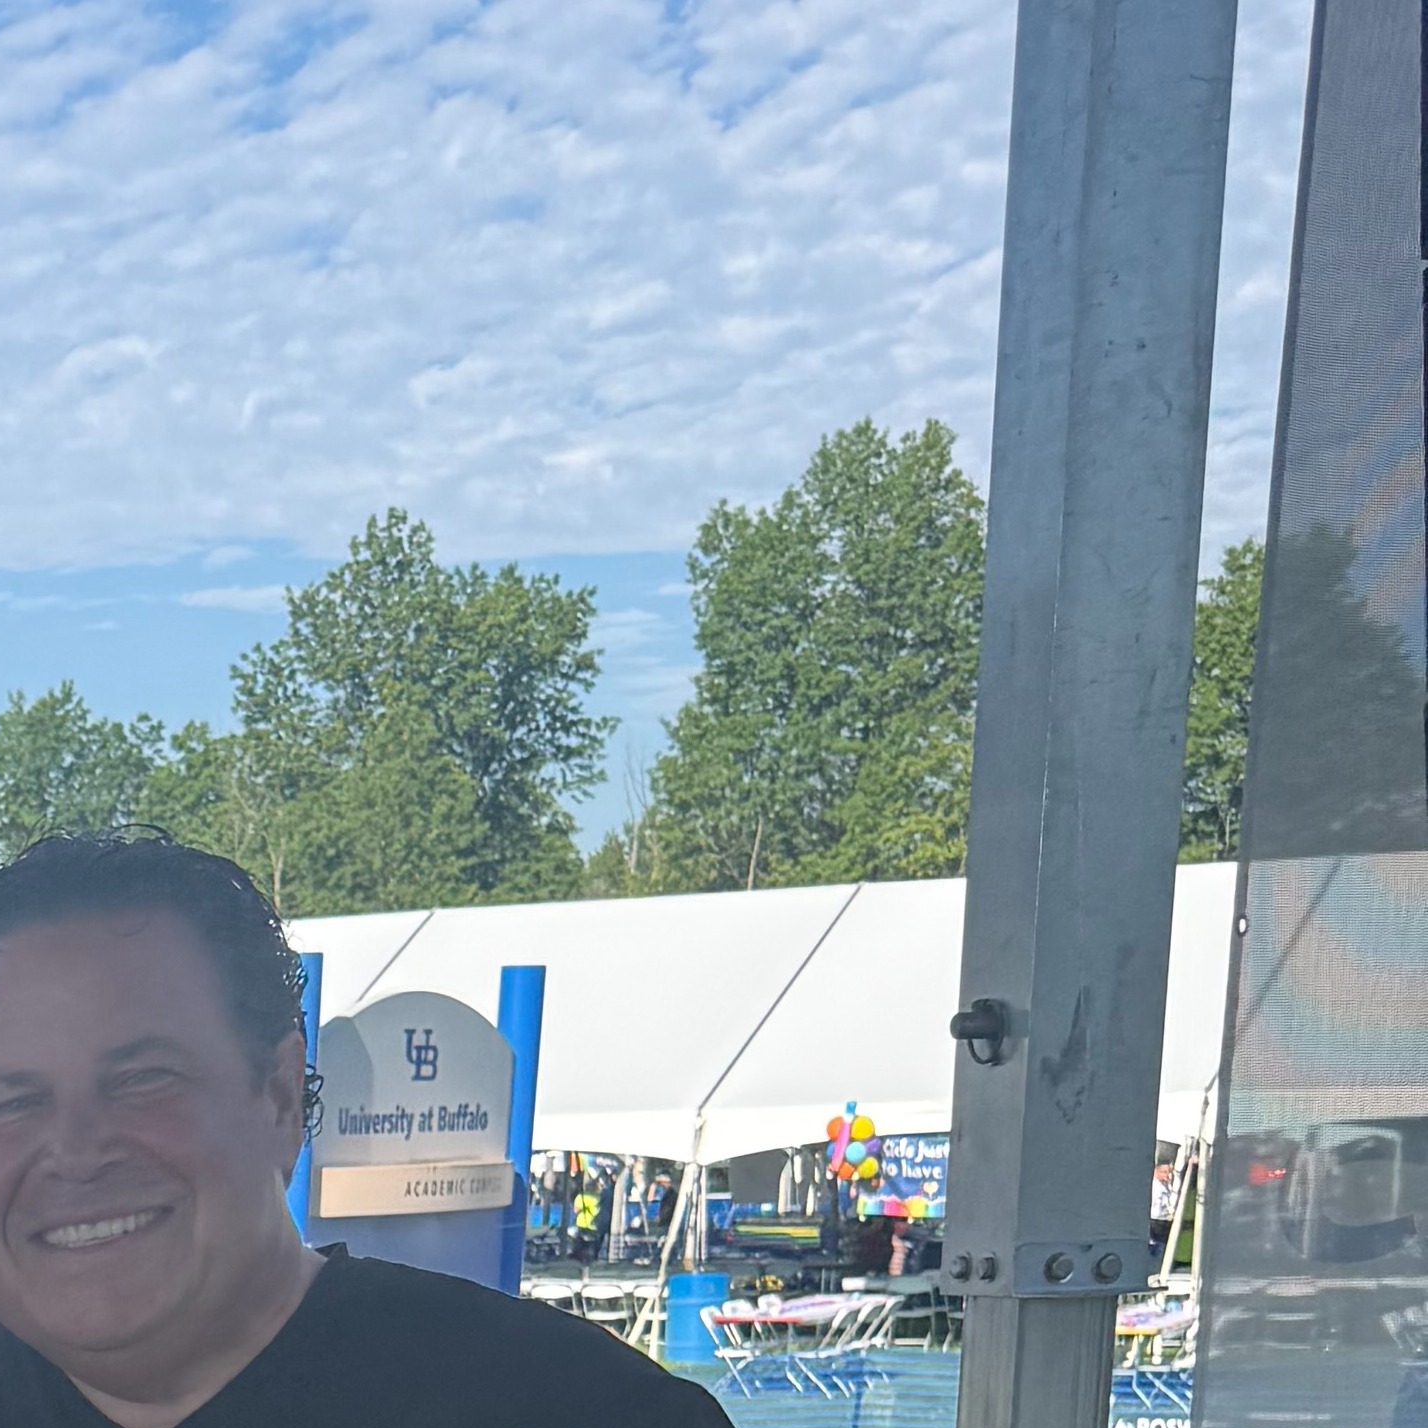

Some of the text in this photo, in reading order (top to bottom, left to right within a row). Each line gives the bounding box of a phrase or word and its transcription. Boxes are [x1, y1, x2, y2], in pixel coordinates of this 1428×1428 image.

[338, 1102, 488, 1141] University at Buffalo
[901, 1158, 944, 1179] have
[404, 1179, 466, 1198] ACADEMIC
